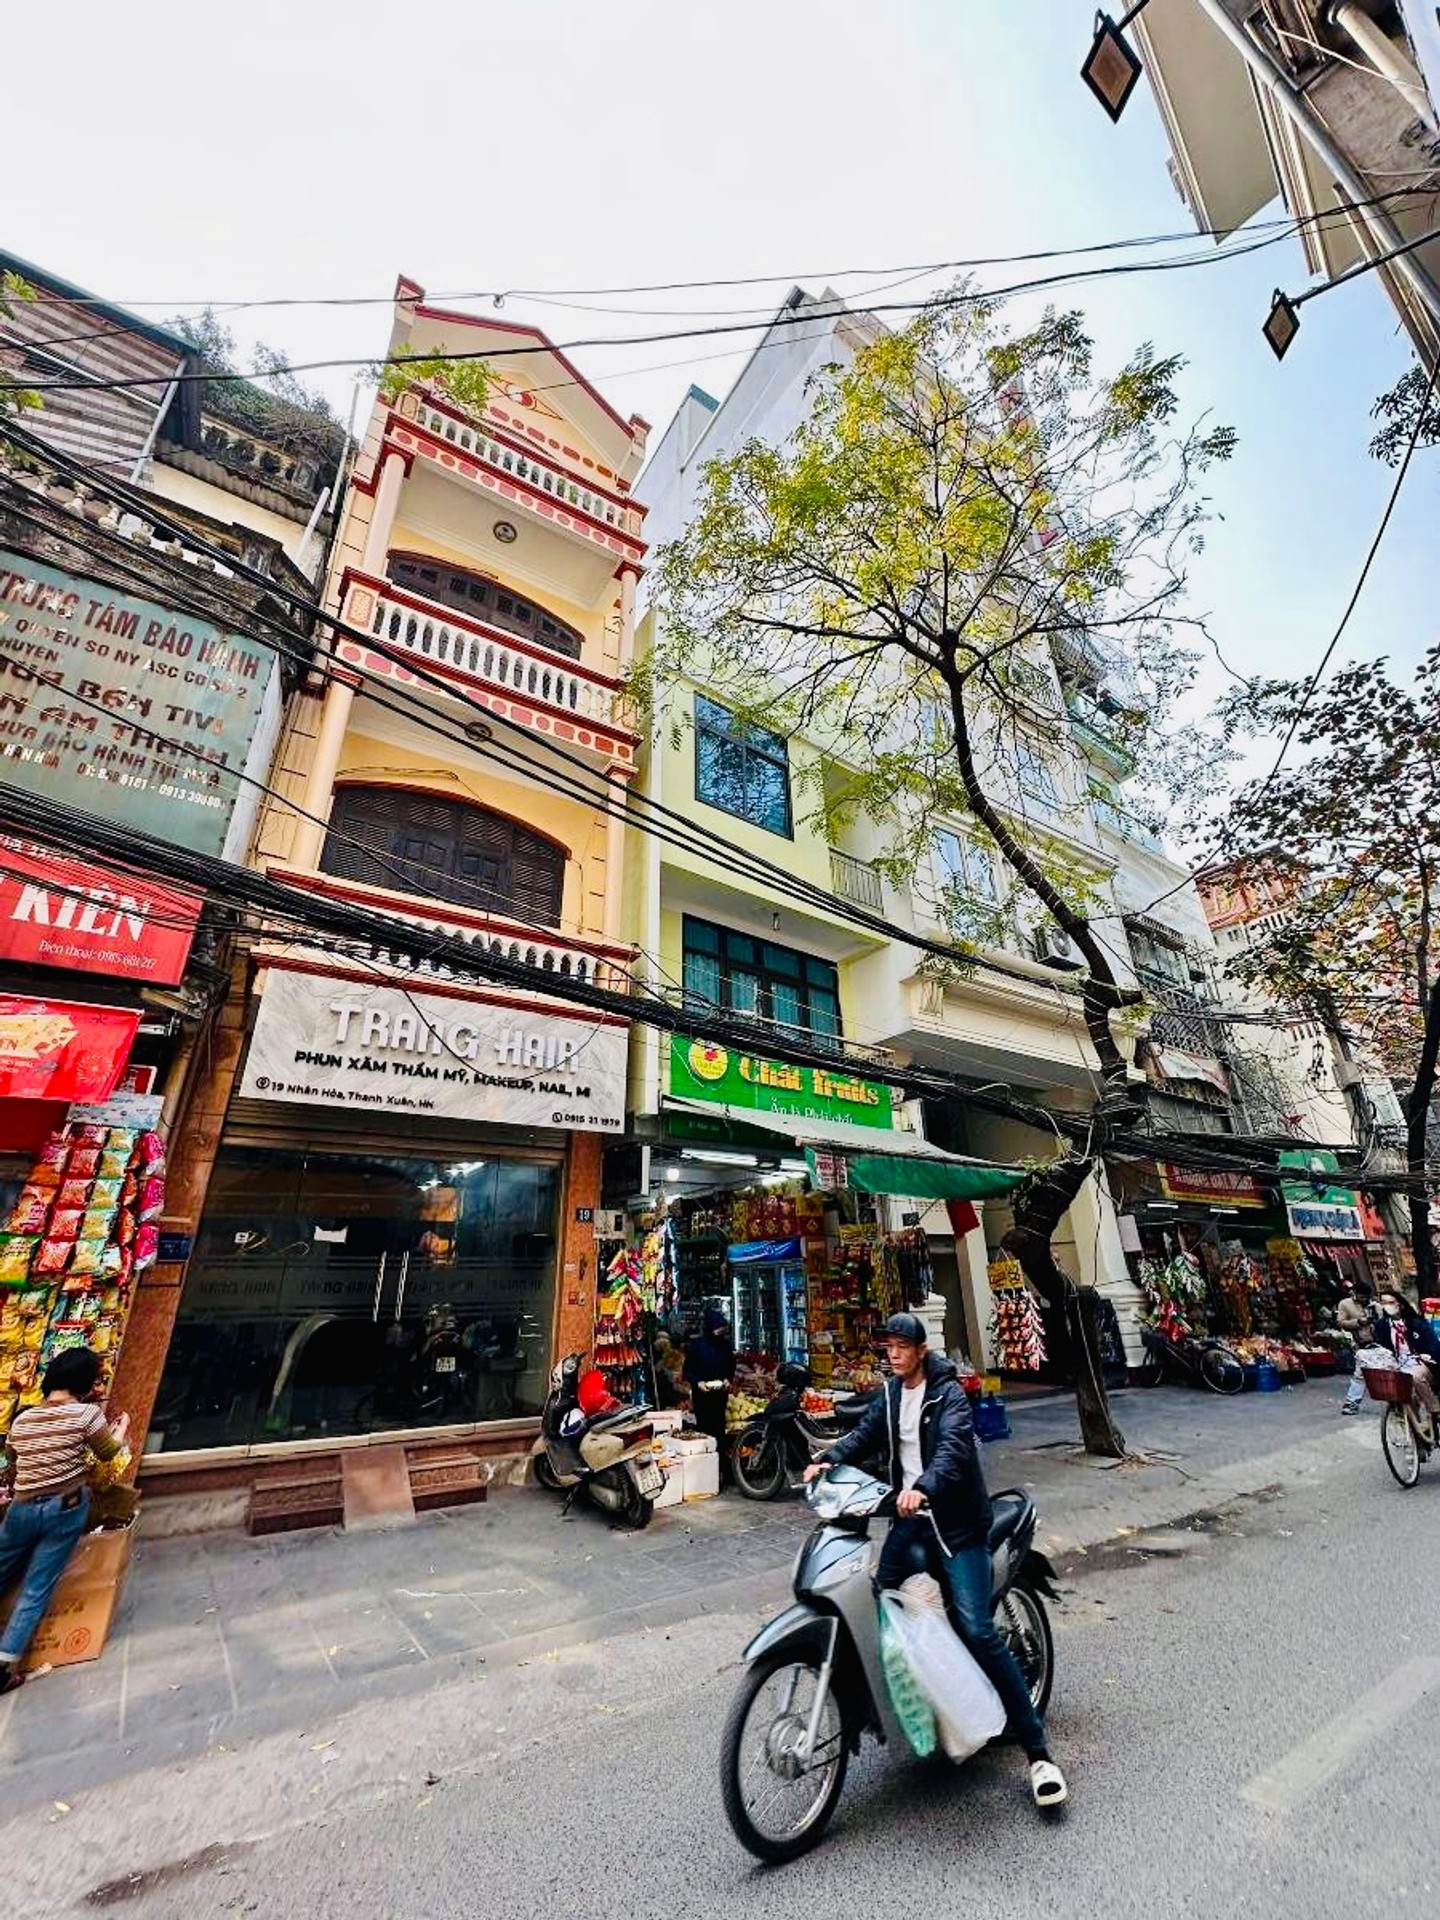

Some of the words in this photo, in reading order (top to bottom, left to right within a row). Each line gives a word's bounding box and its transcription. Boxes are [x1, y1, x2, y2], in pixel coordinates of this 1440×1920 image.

[84, 600, 141, 640] TÂM
[142, 616, 194, 657] BẢO
[330, 1001, 480, 1060] TRANG
[494, 1025, 580, 1075] HAIR
[294, 1049, 343, 1069] PHUN
[347, 1056, 388, 1074] XĂM
[474, 1073, 536, 1094] MAKEUP,
[271, 1081, 285, 1092] 19
[286, 1082, 320, 1097] Nhân
[347, 1091, 383, 1105] Thanh
[385, 1094, 418, 1109] Xuân,
[578, 1209, 591, 1221] 19
